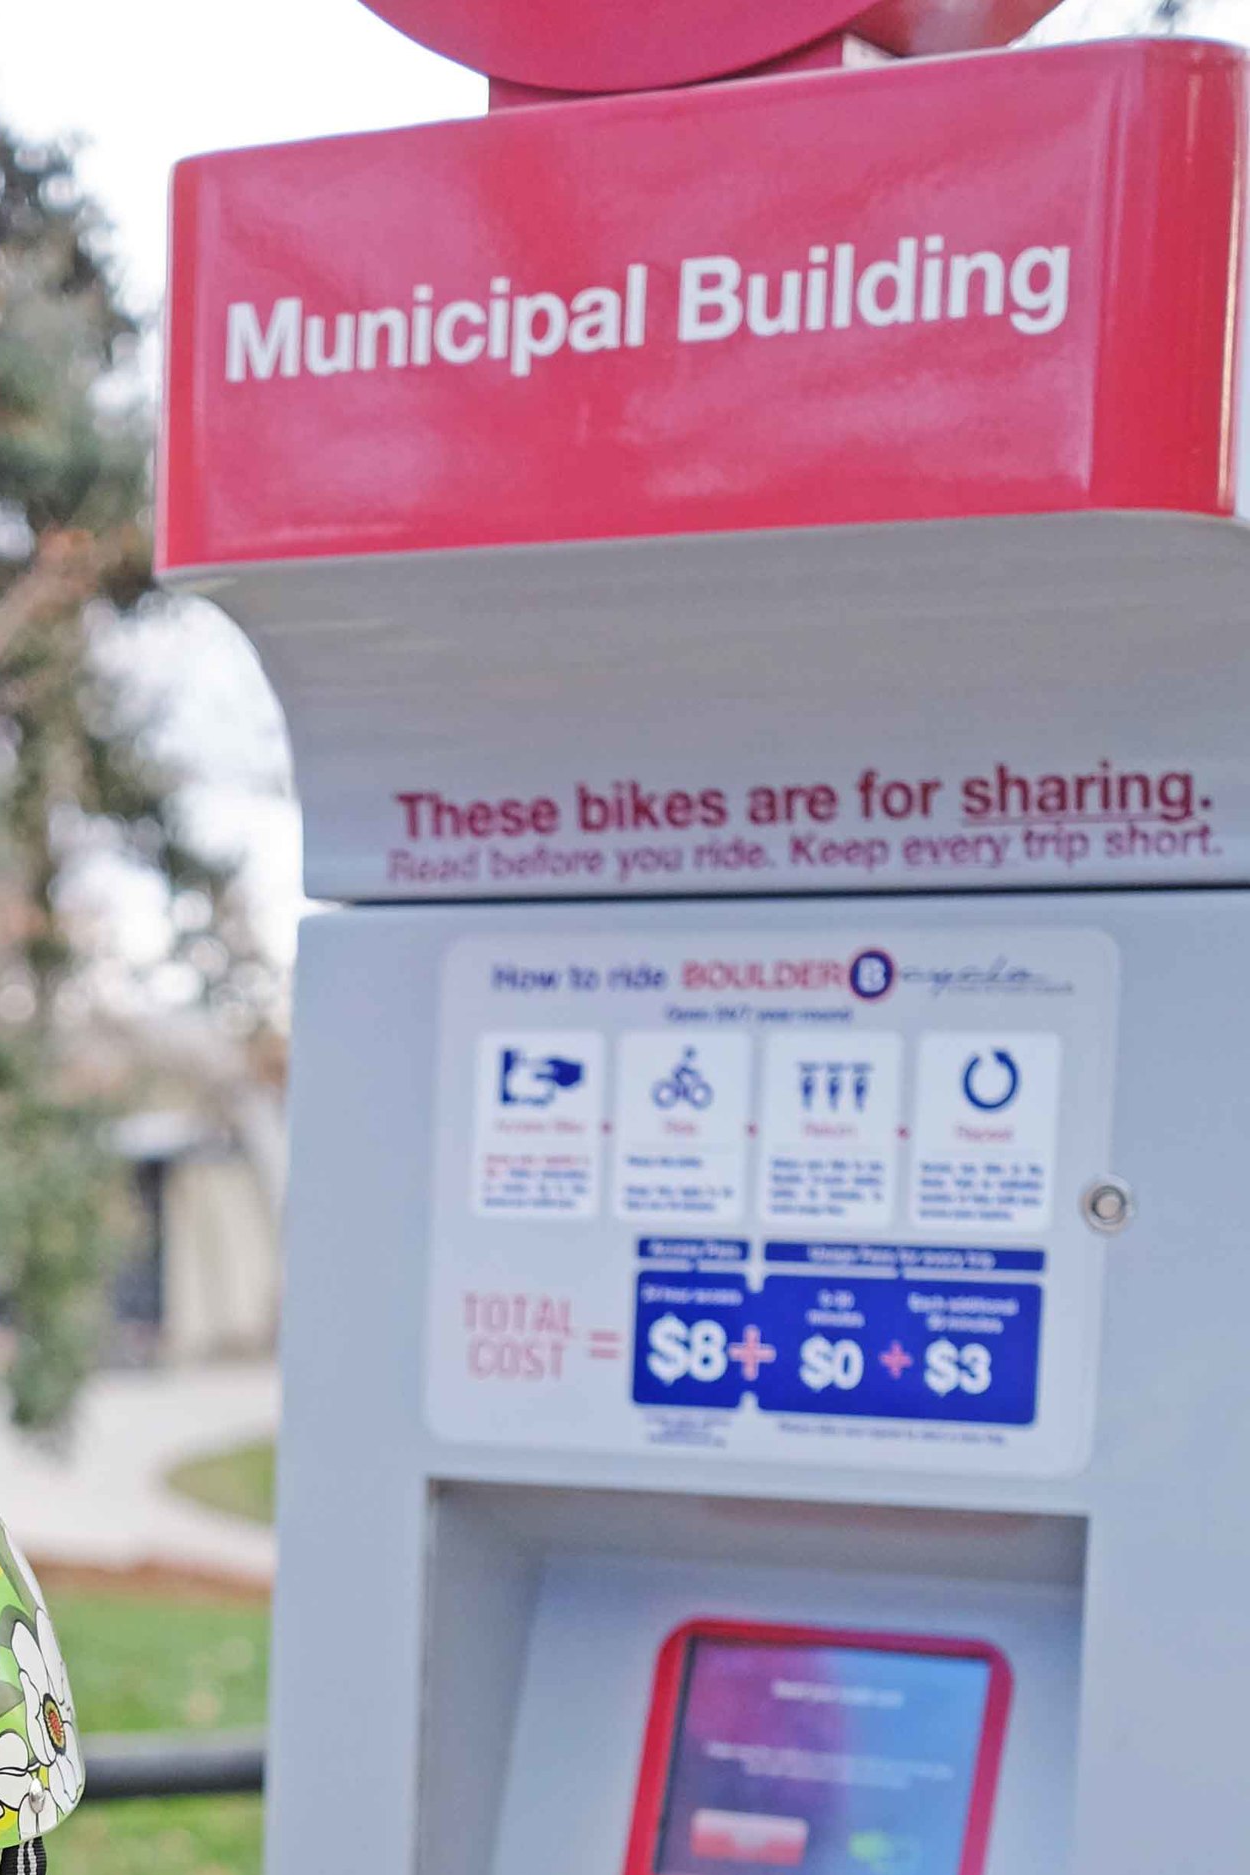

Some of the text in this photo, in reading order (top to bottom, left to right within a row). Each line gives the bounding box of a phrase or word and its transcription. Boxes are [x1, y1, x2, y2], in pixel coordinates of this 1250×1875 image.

[225, 234, 1072, 382] Municipal Building
[393, 759, 1214, 840] These bikes are for sharing.
[388, 820, 1222, 884] Read before you ride. Keep every trip short.
[568, 964, 598, 991] to
[607, 963, 667, 991] ride
[463, 1291, 576, 1338] TOTAL
[469, 1337, 564, 1381] COST
[799, 1334, 865, 1392] $0
[923, 1339, 993, 1397] $3
